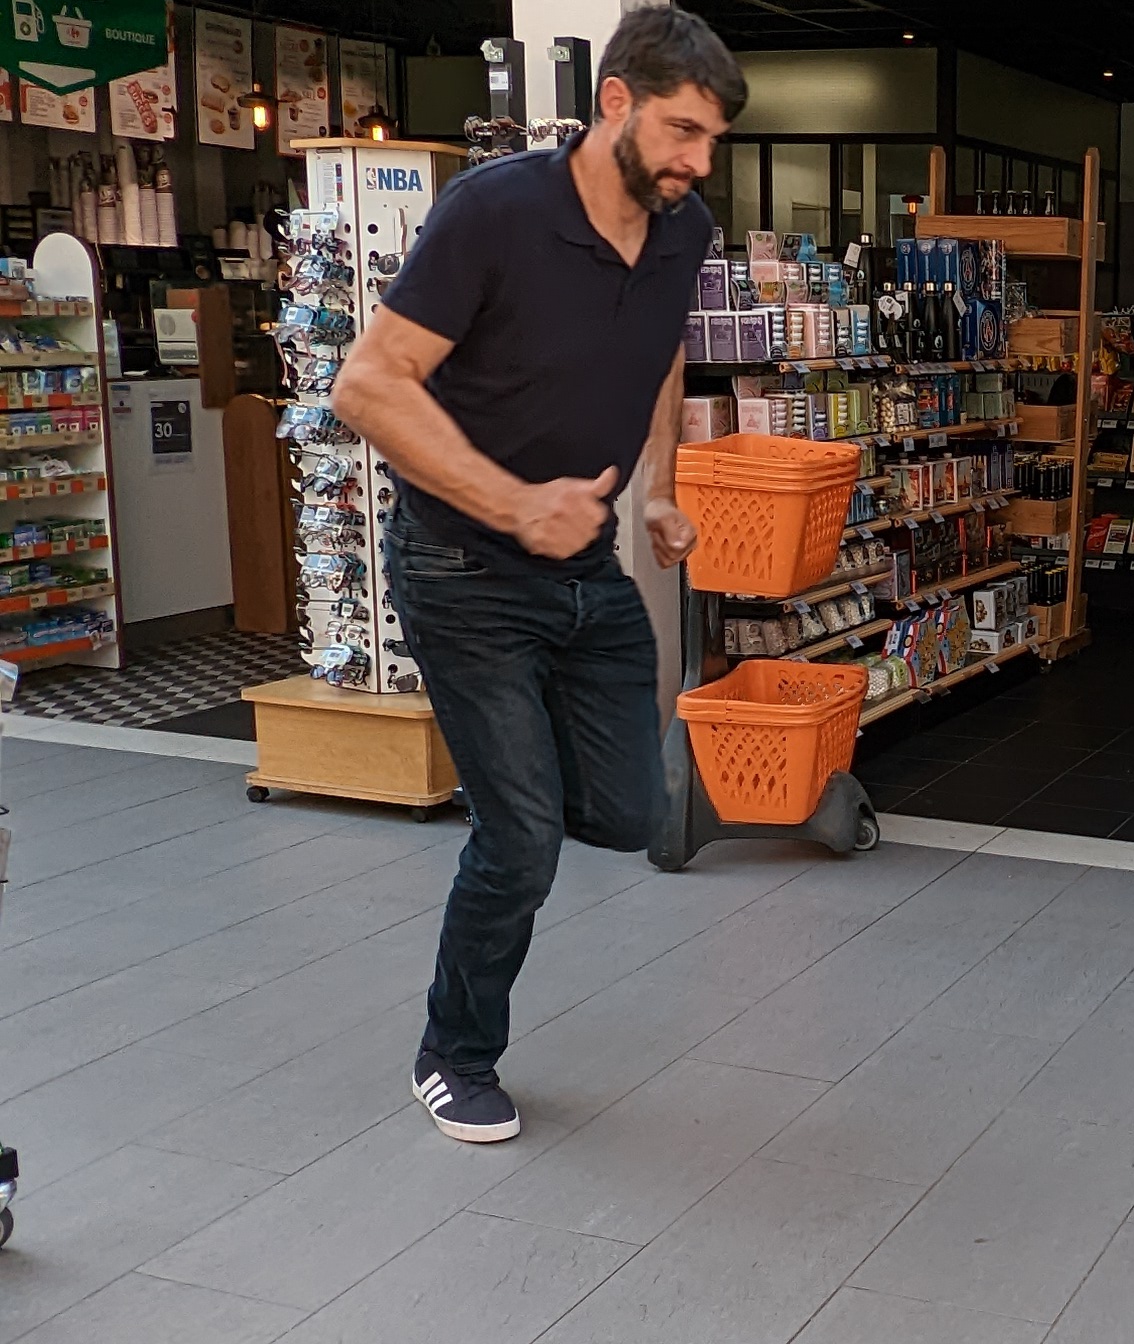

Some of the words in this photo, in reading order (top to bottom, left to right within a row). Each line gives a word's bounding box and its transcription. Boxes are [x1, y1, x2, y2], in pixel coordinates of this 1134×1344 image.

[105, 27, 156, 46] BOUTIQUE
[377, 167, 424, 192] NBA
[154, 422, 173, 438] 30
